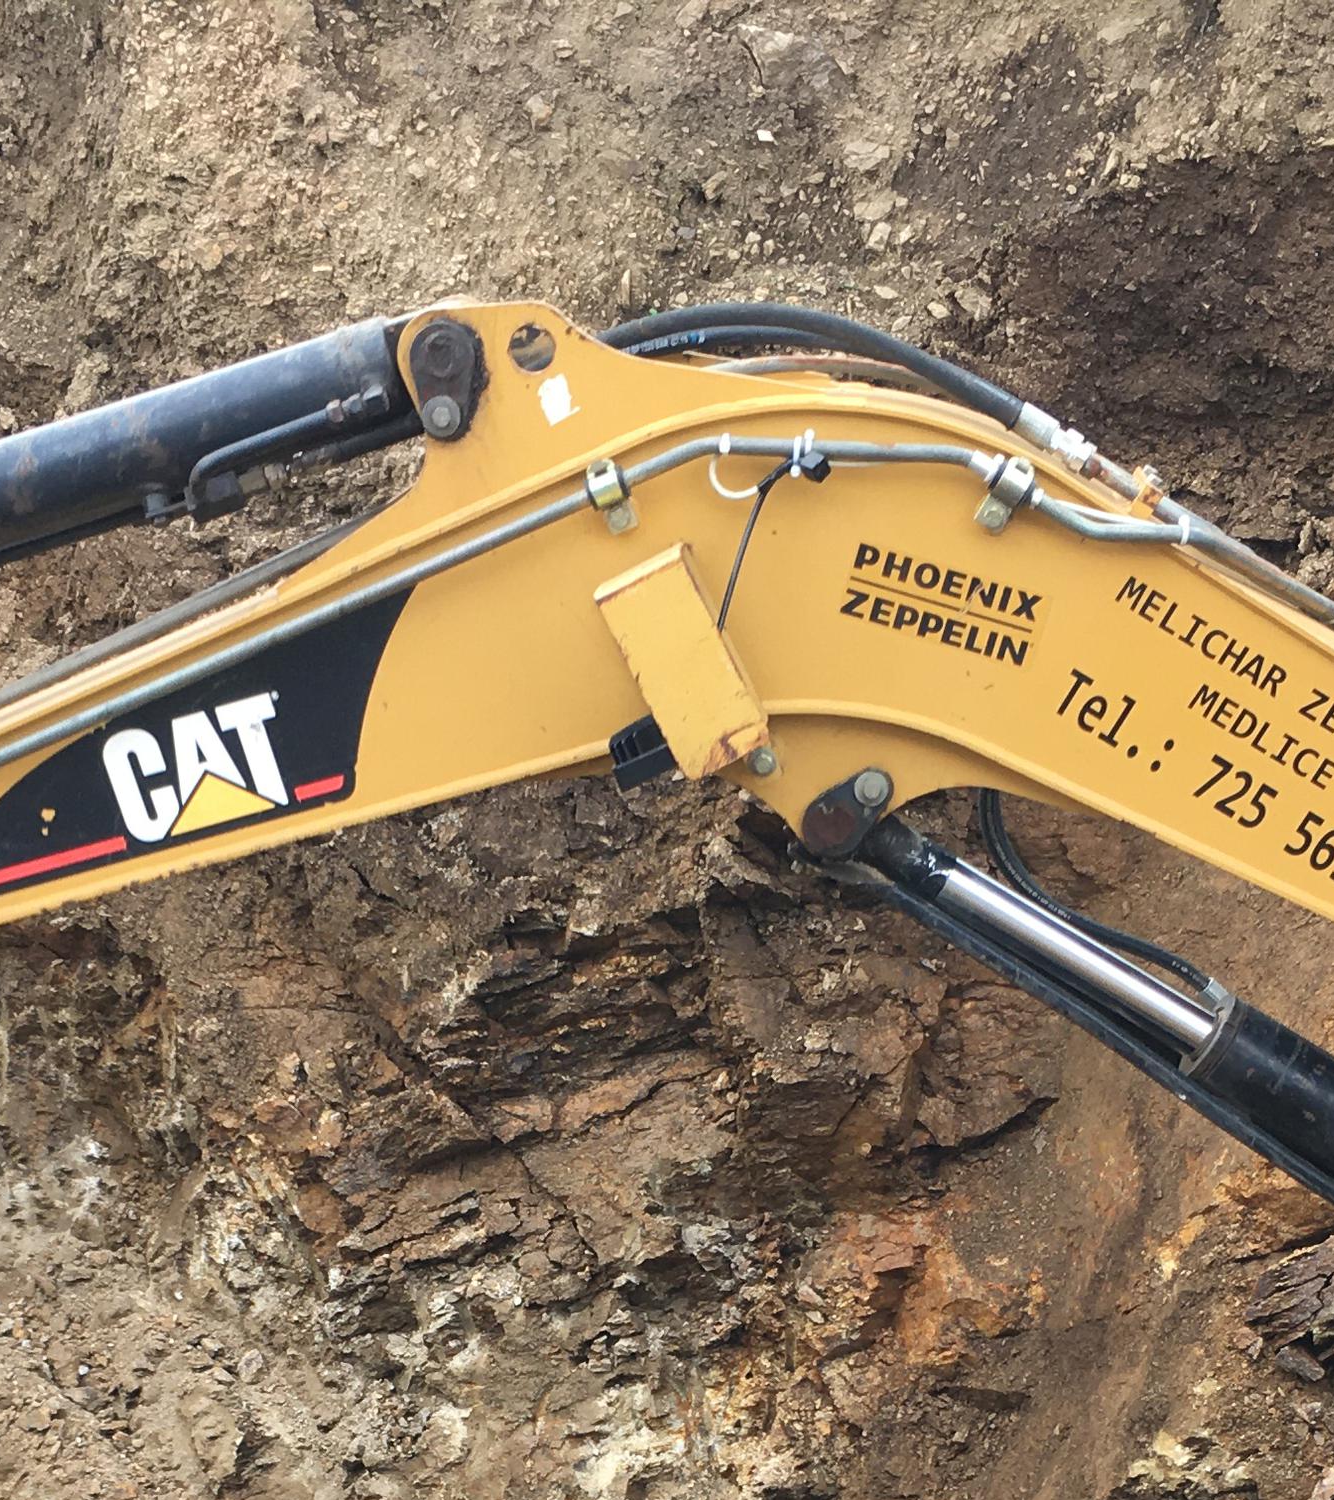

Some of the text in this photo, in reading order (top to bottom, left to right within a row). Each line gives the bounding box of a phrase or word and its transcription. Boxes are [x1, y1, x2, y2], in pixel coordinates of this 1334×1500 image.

[839, 587, 1030, 667] ZEPPELIN
[852, 542, 1043, 622] PHOENIX
[1114, 575, 1288, 698] MELICHAR
[102, 691, 289, 842] CAT
[1056, 667, 1176, 773] Tel.:
[1192, 753, 1280, 829] 725
